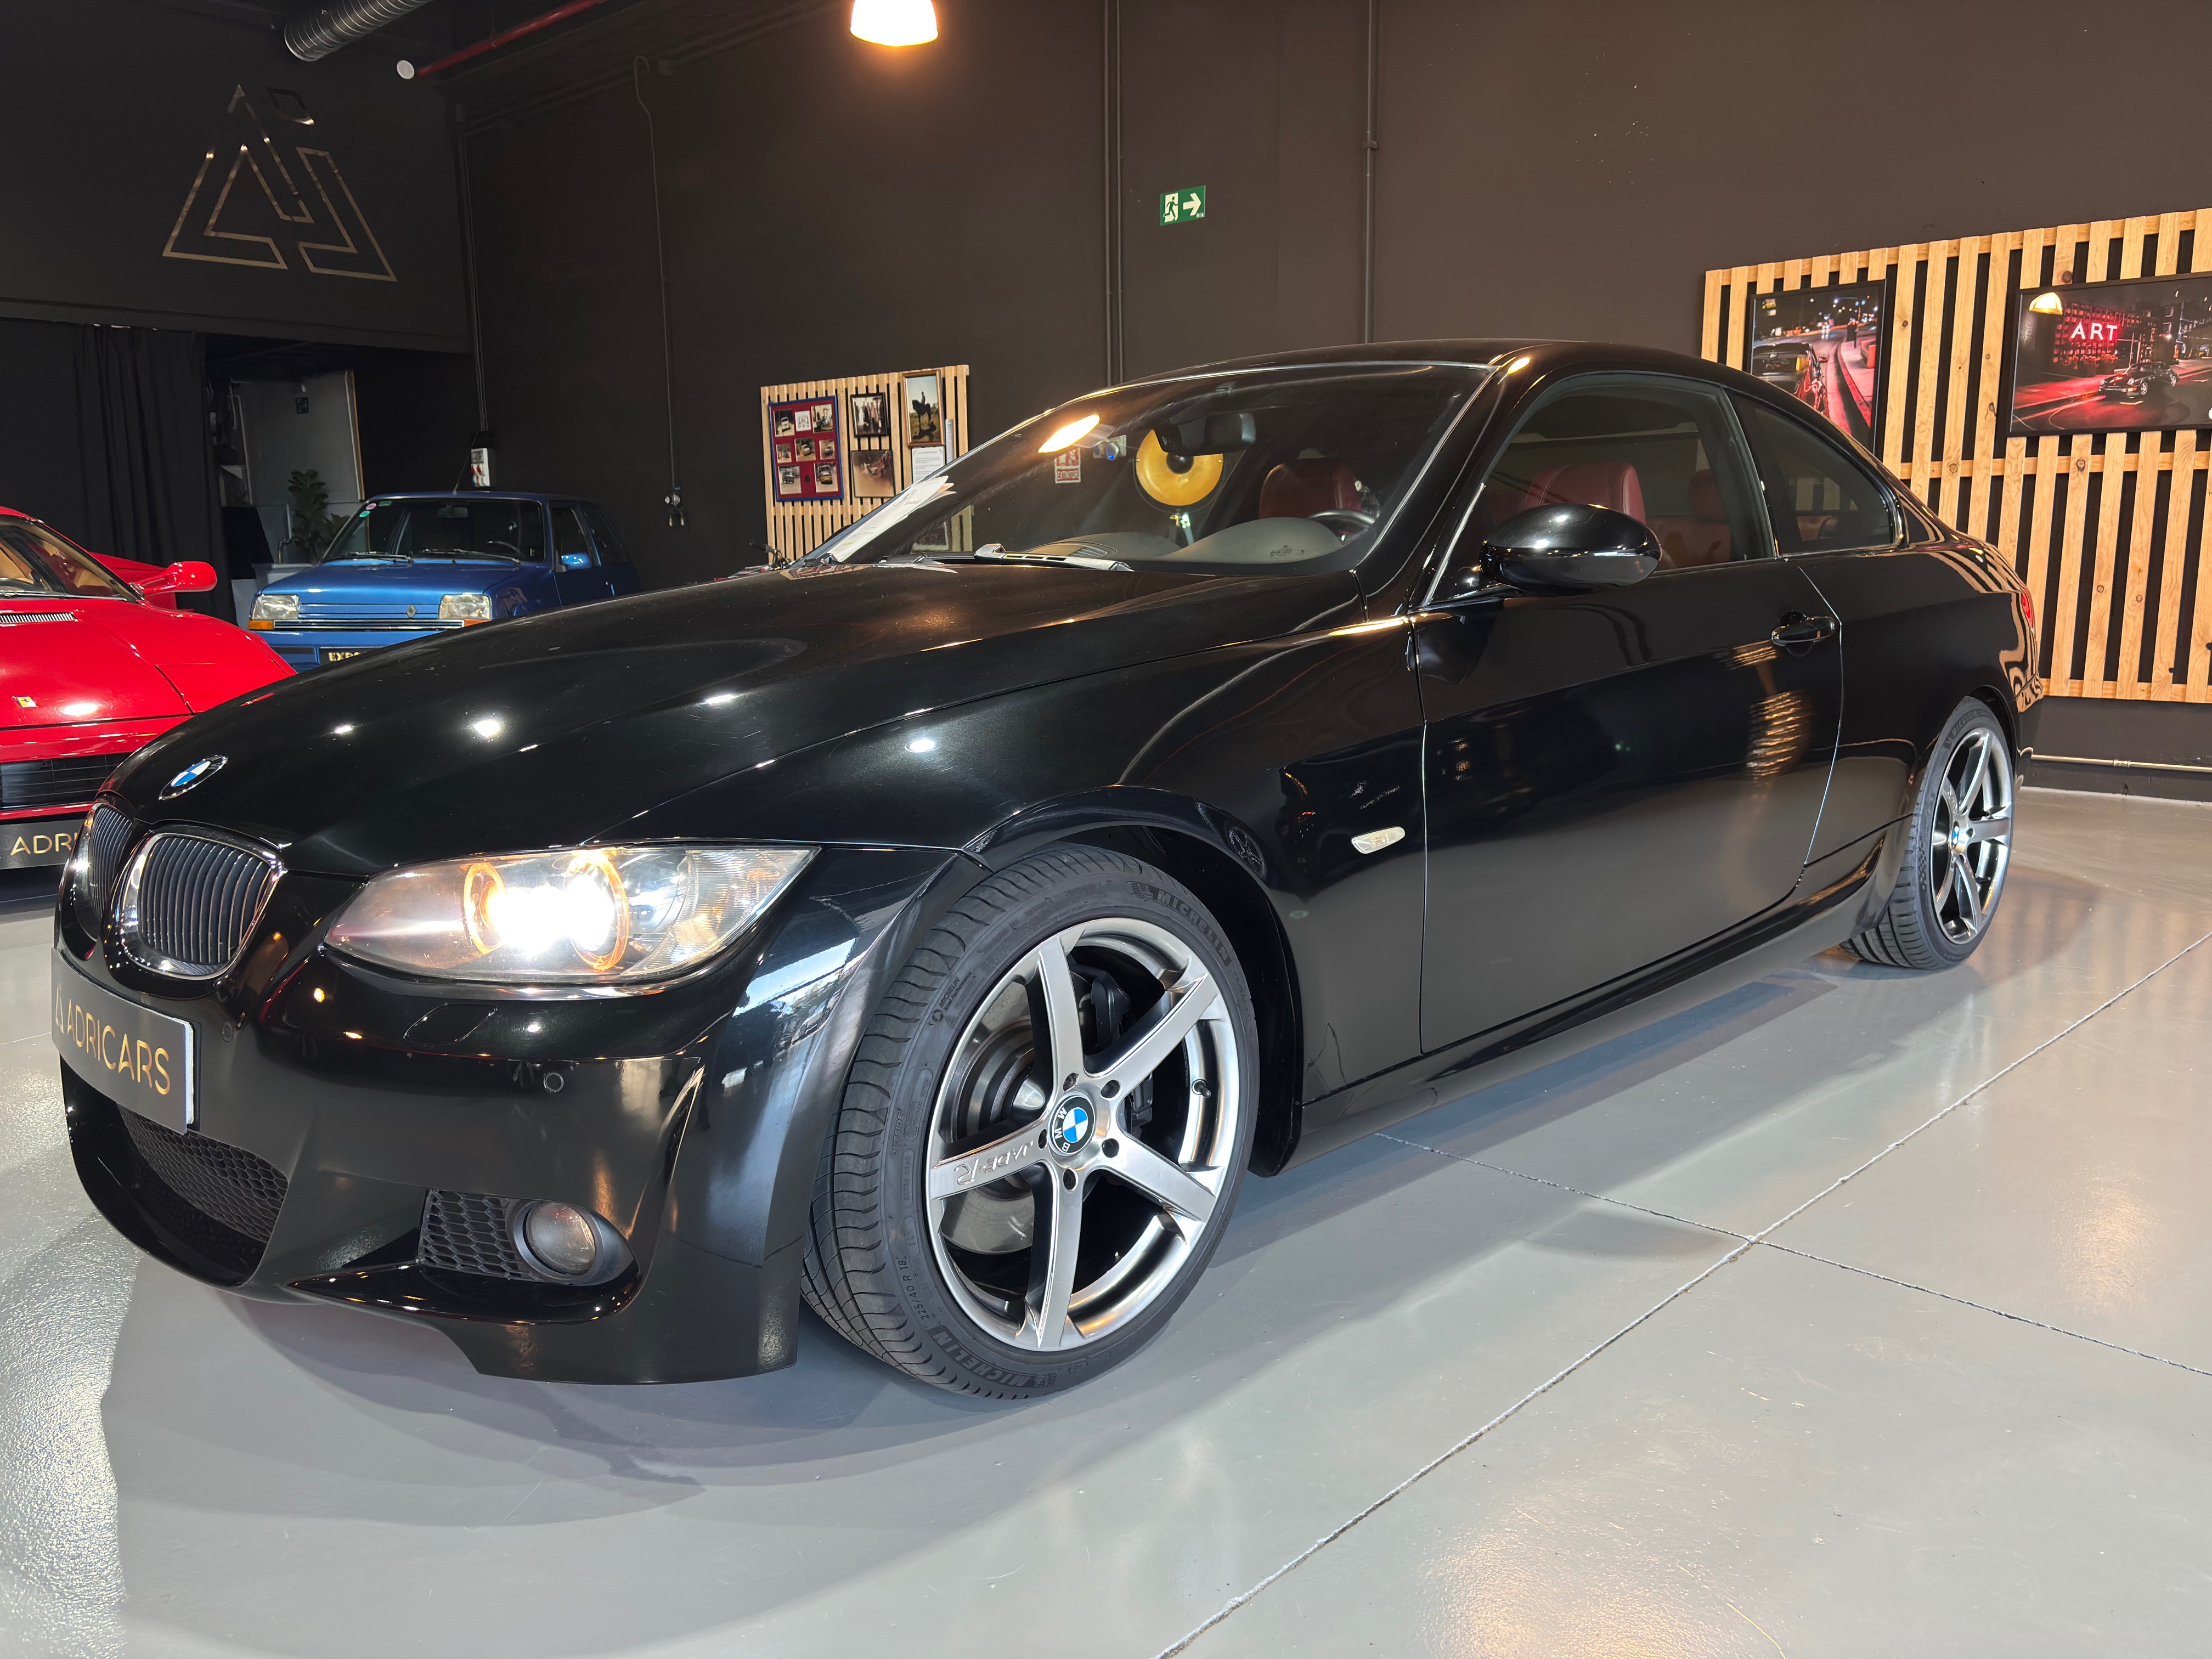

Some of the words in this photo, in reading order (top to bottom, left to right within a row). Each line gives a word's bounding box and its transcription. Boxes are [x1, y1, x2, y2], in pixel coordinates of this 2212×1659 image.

[2070, 321, 2118, 341] ART
[1157, 890, 1230, 961] MICHELIN
[939, 977, 960, 1008] MICHELIN
[67, 999, 171, 1095] ADRICARS
[899, 1260, 908, 1271] 18
[906, 1285, 930, 1320] 225/40
[932, 1331, 1030, 1387] MICHELIN
